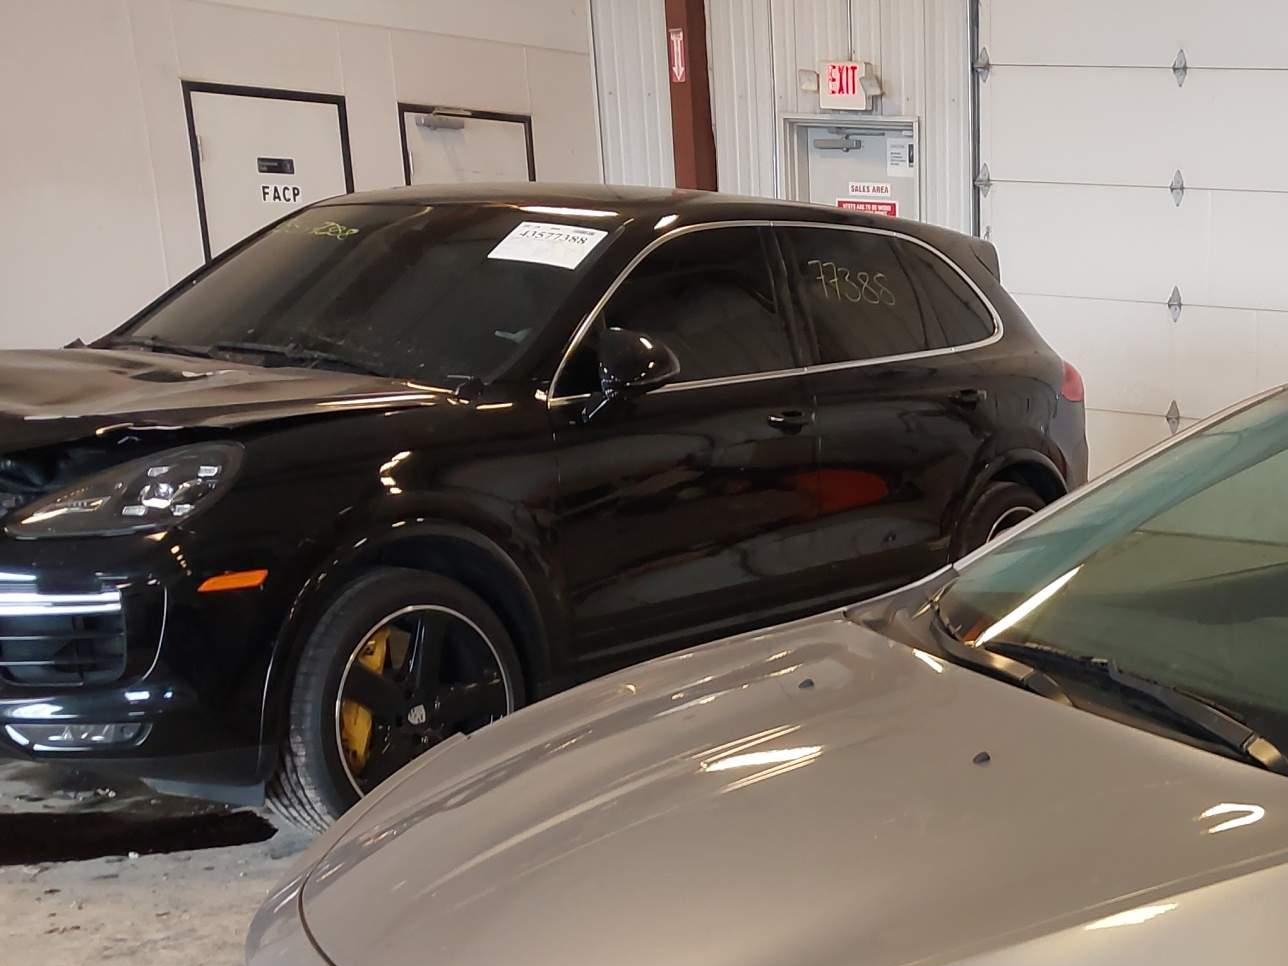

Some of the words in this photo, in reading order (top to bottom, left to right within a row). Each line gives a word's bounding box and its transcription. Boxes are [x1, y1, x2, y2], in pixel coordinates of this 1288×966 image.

[827, 65, 857, 95] EXIT
[262, 185, 300, 202] FACP
[851, 185, 870, 193] SALES
[871, 185, 889, 193] AREA
